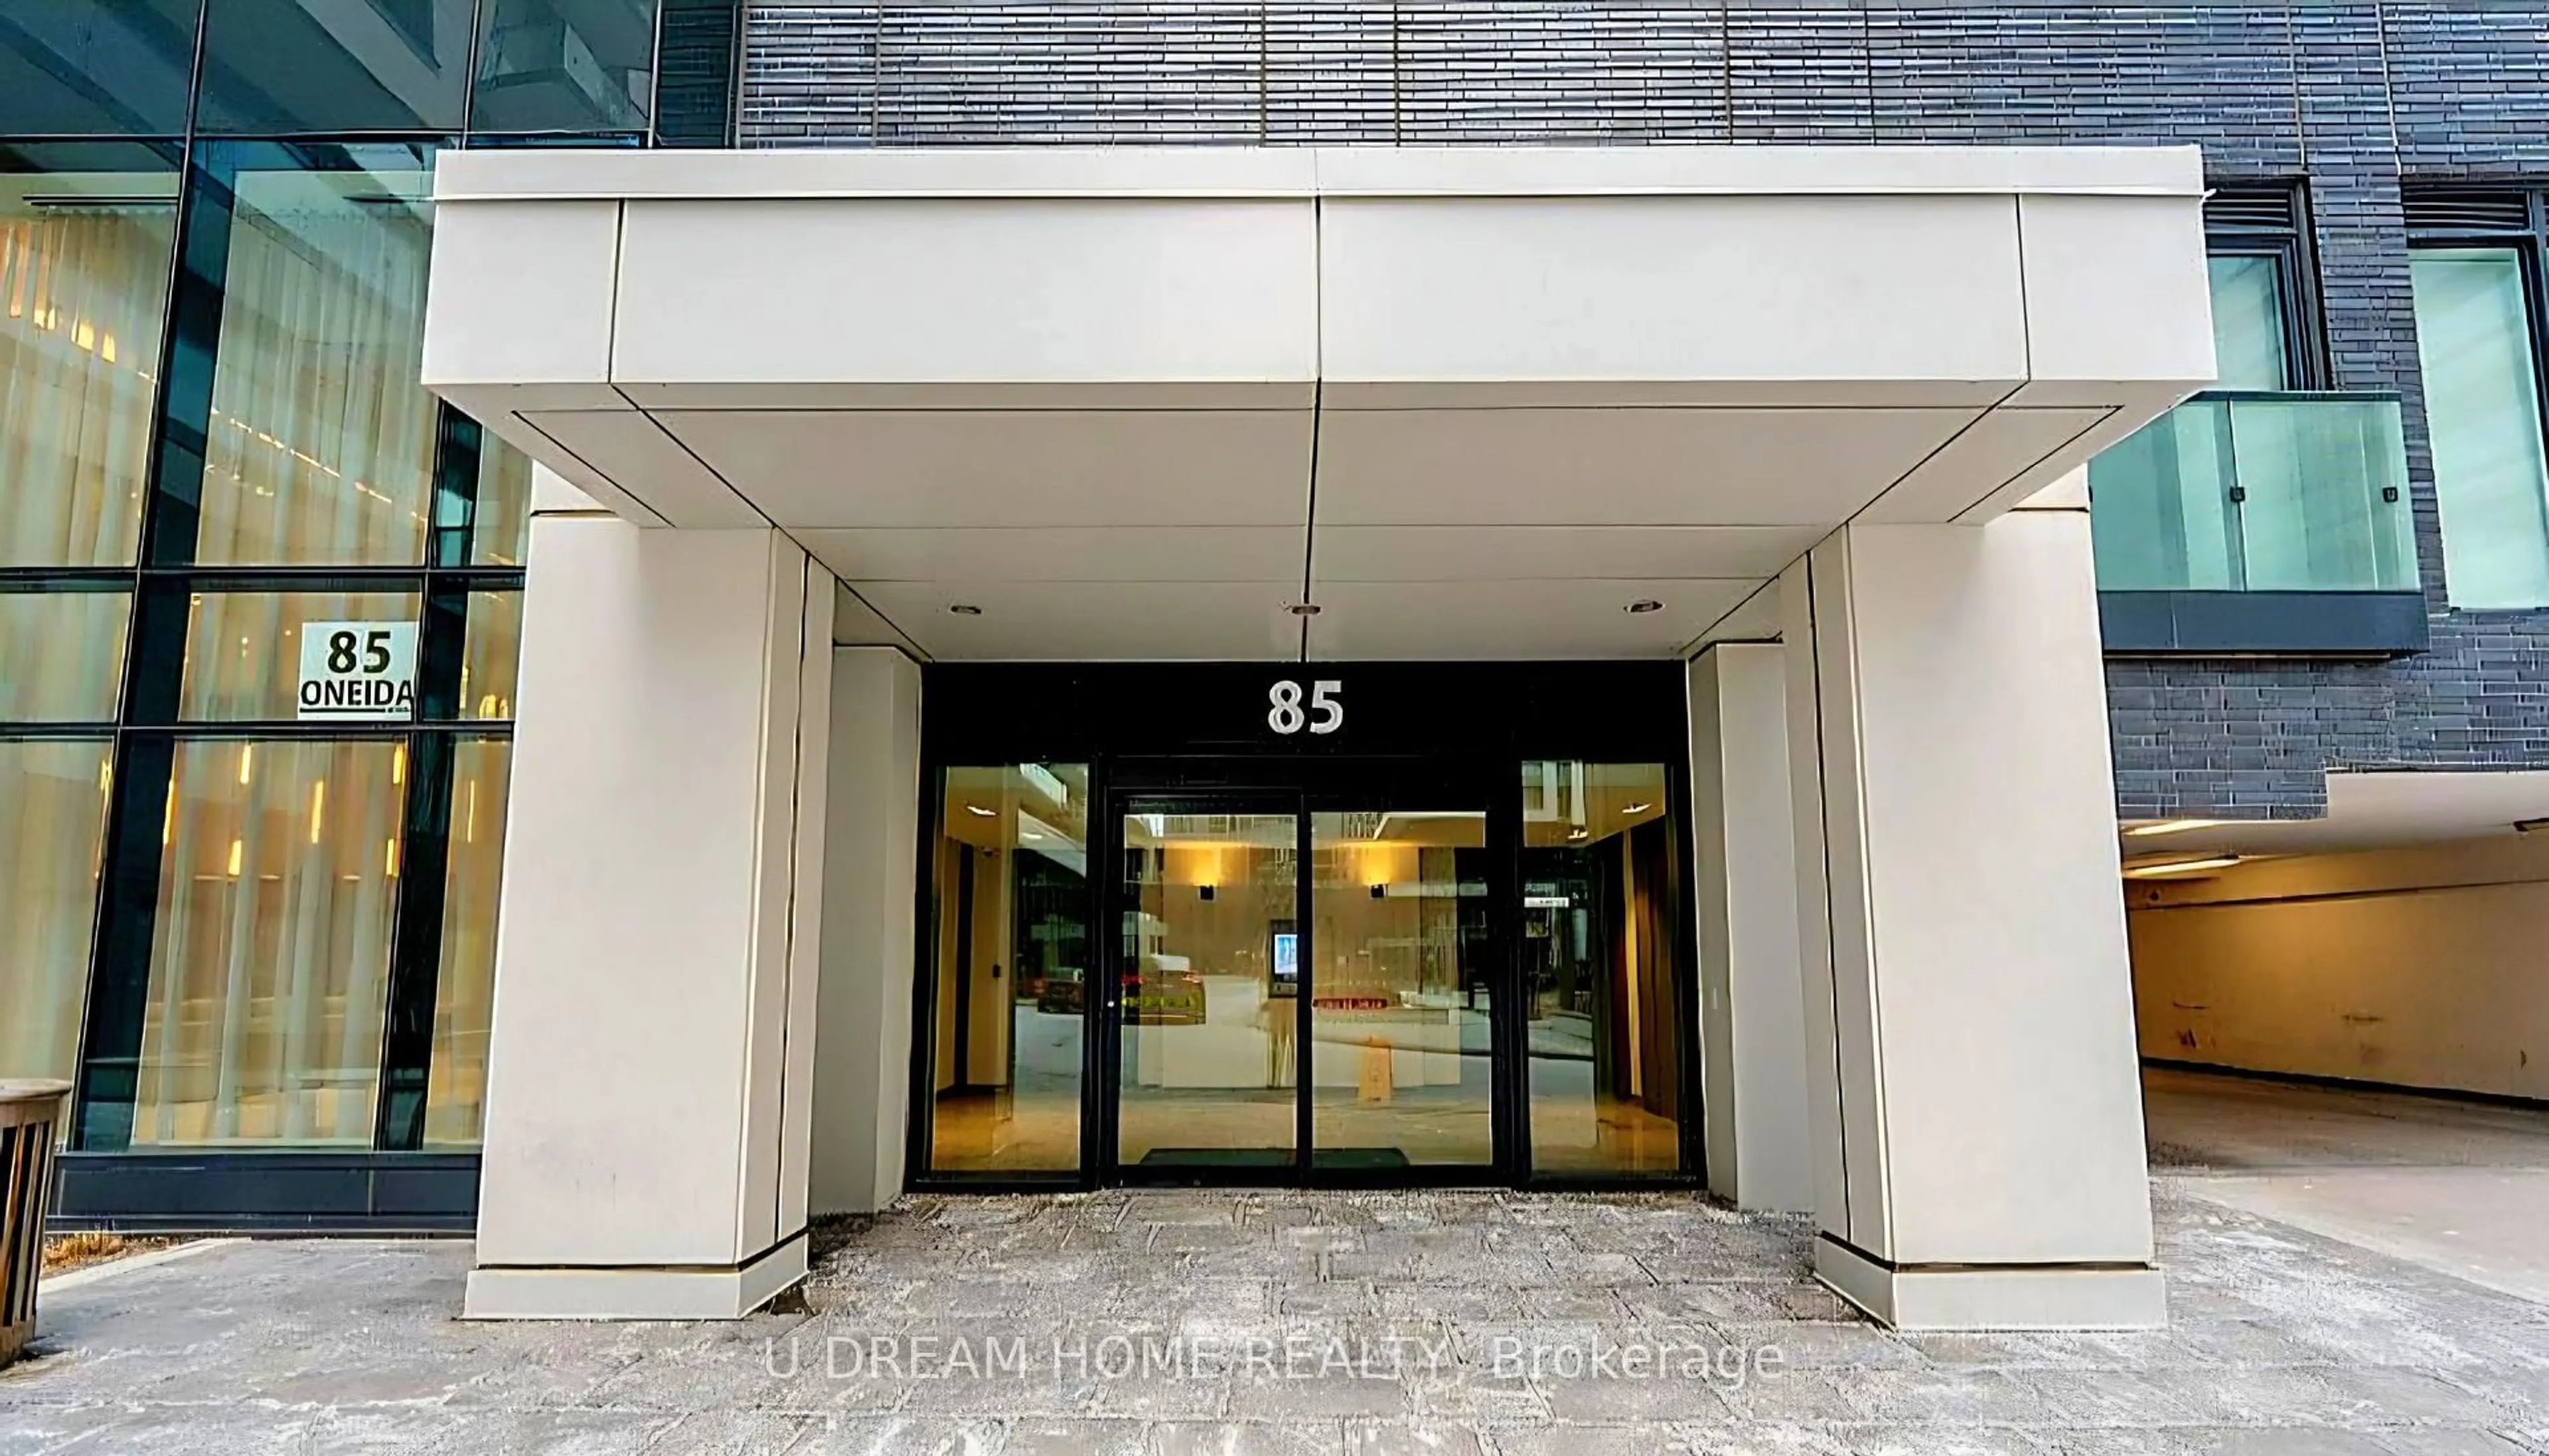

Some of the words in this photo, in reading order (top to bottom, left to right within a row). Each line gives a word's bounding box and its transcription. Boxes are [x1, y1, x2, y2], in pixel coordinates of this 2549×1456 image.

[328, 630, 392, 674] 85
[300, 680, 414, 706] ONEIDA
[1267, 679, 1344, 735] 85
